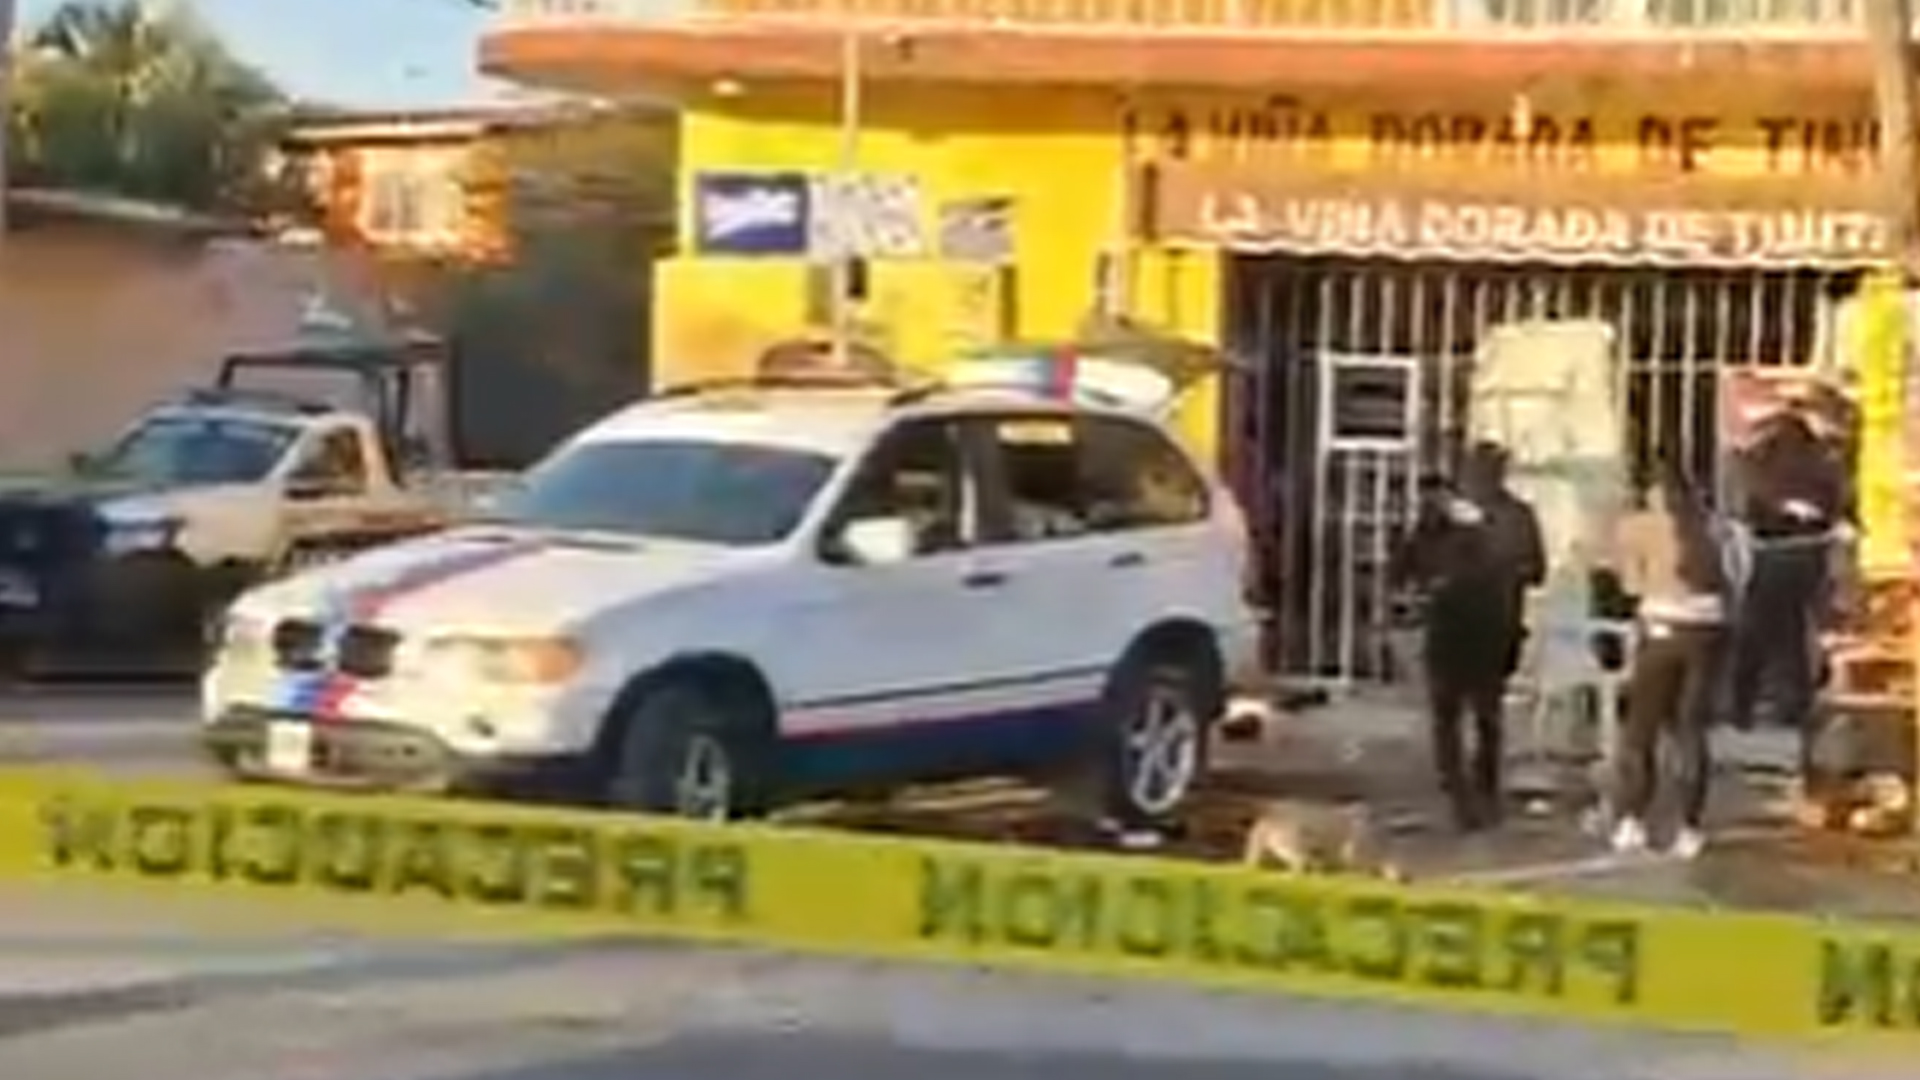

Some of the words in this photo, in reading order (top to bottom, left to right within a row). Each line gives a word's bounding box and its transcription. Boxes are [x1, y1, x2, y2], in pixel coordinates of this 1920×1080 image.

[1370, 112, 1594, 169] DORADA
[1638, 116, 1718, 173] DE
[1202, 190, 1260, 232] LA
[1420, 200, 1634, 249] DORADA
[1645, 210, 1712, 252] DE
